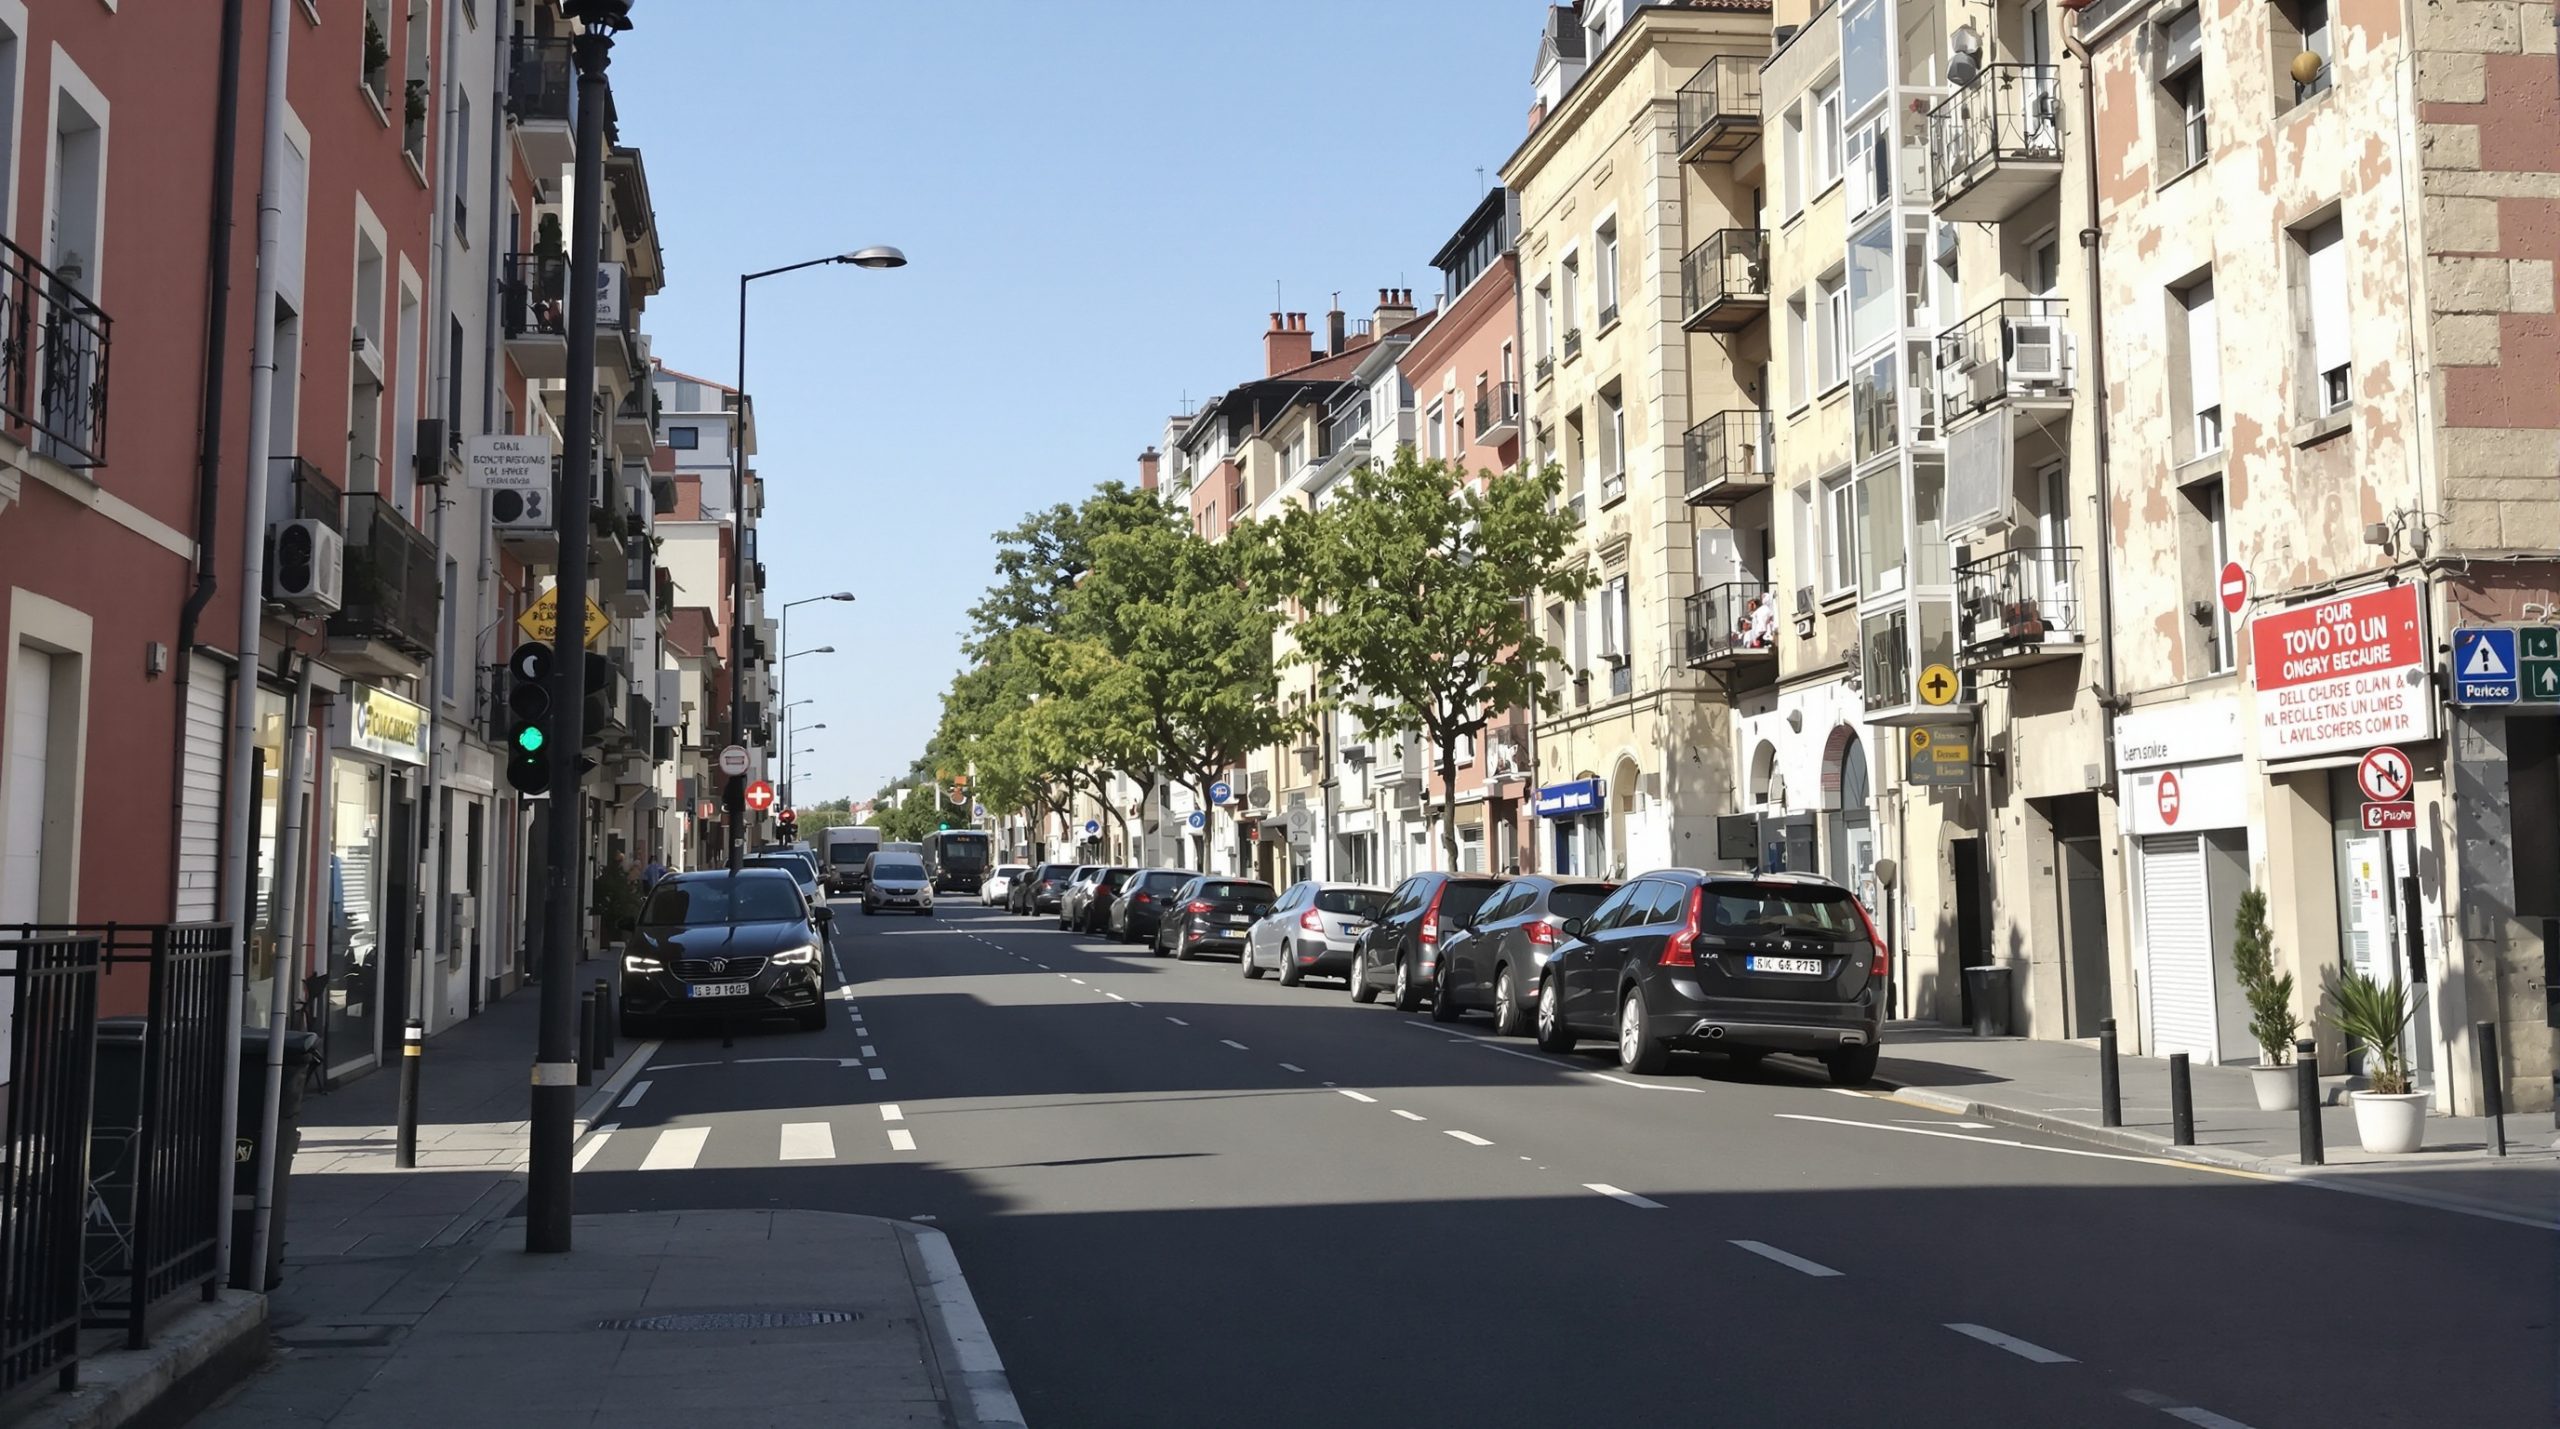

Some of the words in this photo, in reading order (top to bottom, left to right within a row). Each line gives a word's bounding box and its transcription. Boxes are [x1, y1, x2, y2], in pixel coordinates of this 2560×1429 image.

[2316, 602, 2353, 625] FOUR
[2282, 626, 2331, 656] TOVO
[2333, 622, 2357, 647] TO
[2360, 615, 2388, 643] UN
